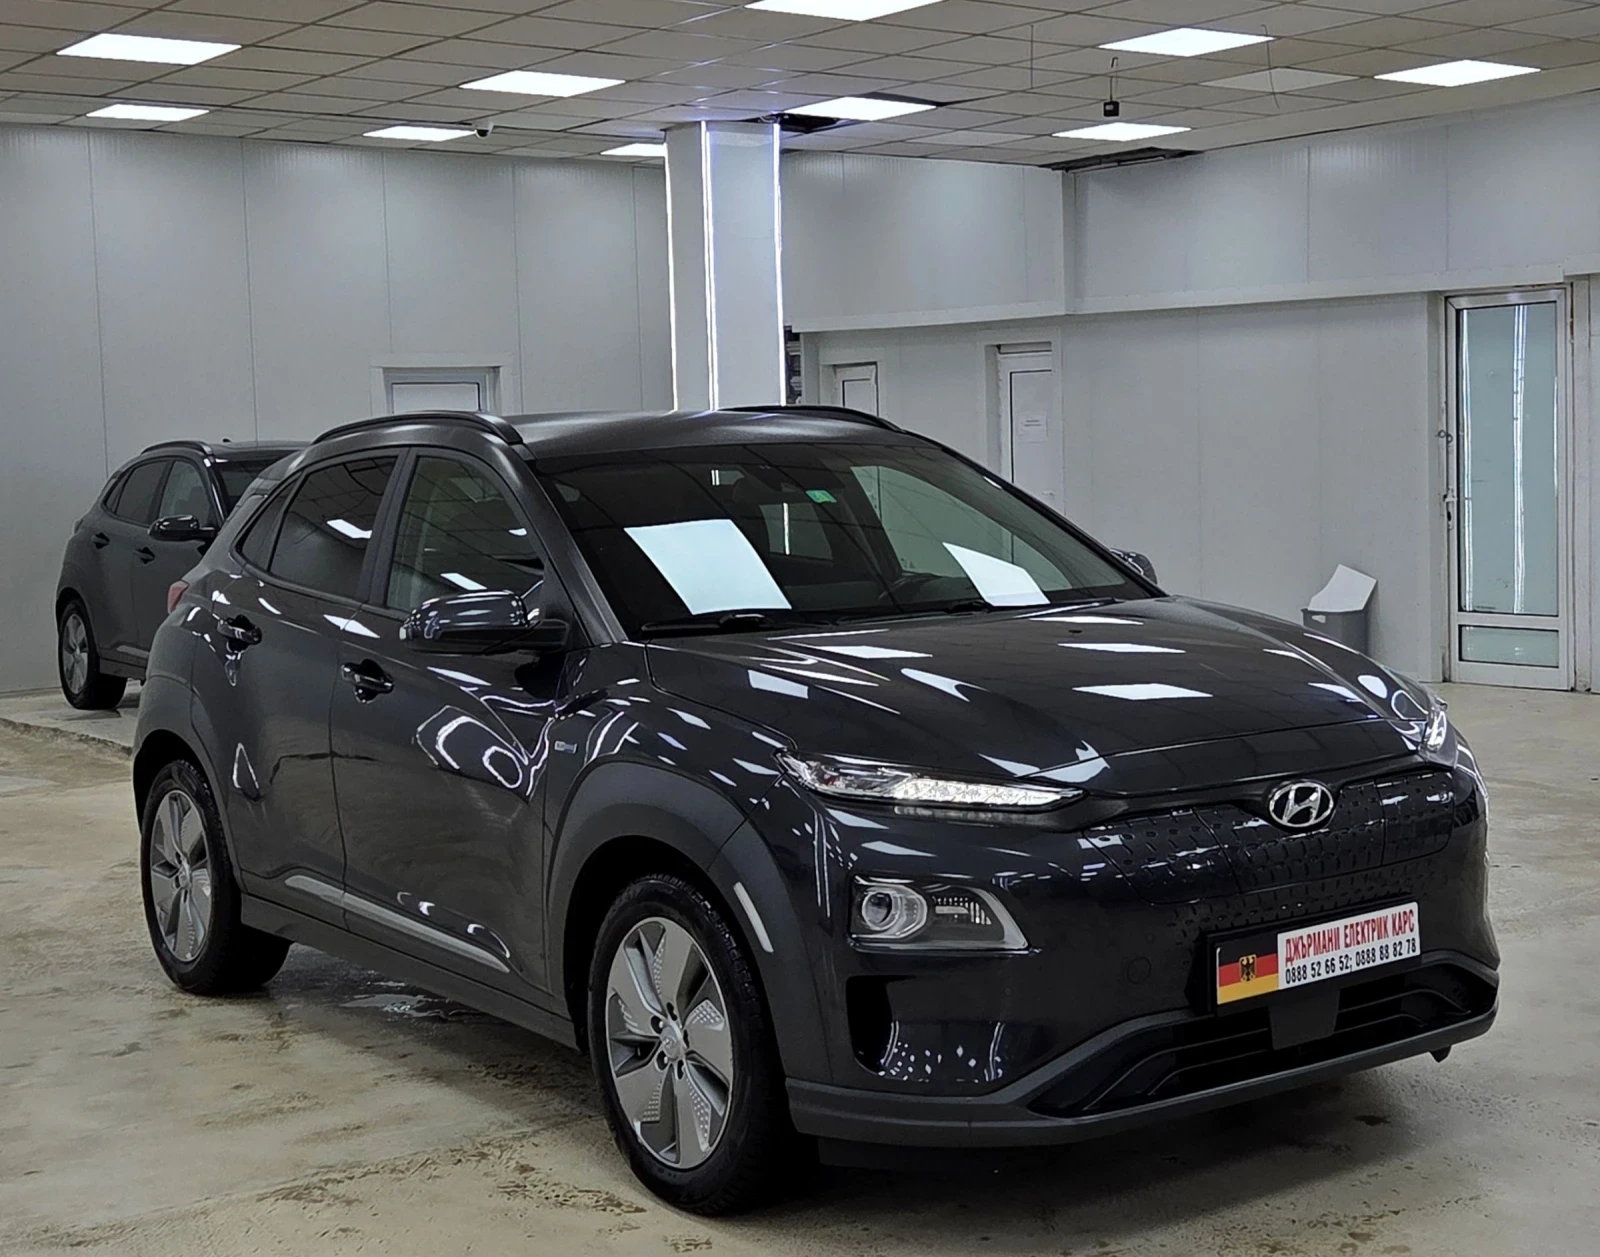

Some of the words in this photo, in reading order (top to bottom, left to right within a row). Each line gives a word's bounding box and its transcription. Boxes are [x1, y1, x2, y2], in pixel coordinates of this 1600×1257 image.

[1285, 927, 1340, 967] ДЖЪРМАНИ
[1344, 915, 1389, 948] ЕЛЕКТРИК
[1391, 909, 1415, 937] КАРС
[1285, 967, 1308, 984] 0888
[1311, 961, 1322, 978] 52
[1325, 957, 1336, 975] 66
[1339, 953, 1352, 972] 52;
[1355, 949, 1376, 967] 0888
[1379, 945, 1390, 961] 88
[1393, 941, 1403, 957] 82
[1406, 937, 1416, 953] 78
